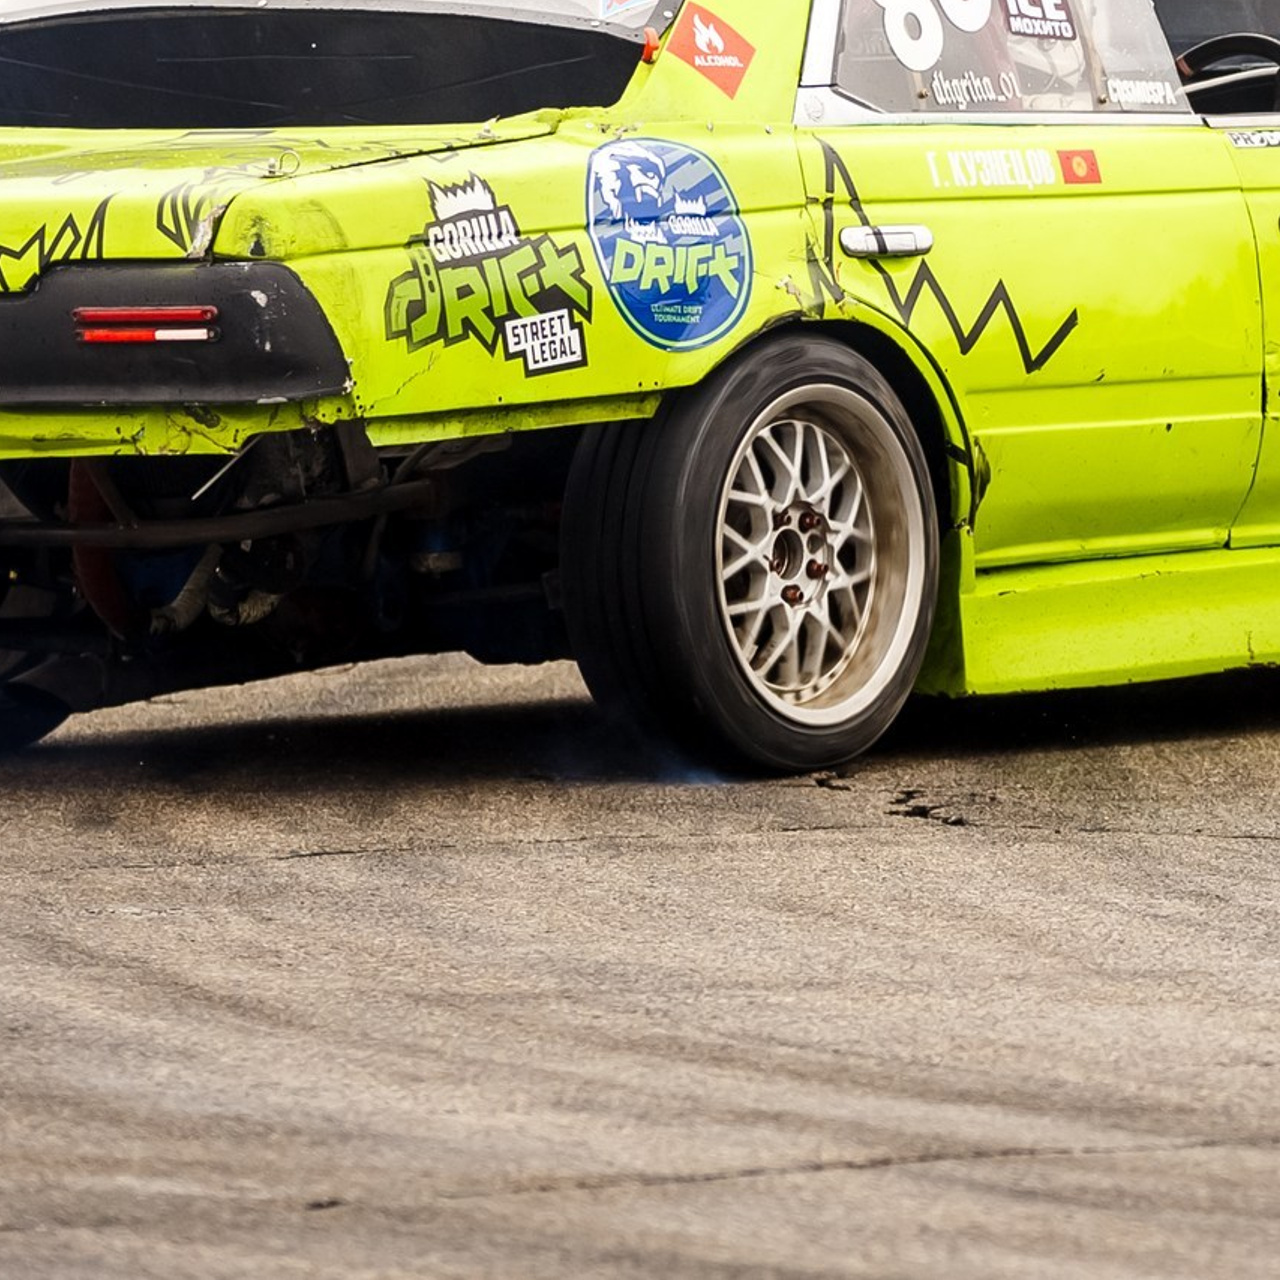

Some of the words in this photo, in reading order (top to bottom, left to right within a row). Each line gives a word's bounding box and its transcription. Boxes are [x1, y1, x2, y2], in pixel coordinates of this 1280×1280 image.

[1009, 16, 1075, 39] МОХИТО
[926, 150, 950, 188] Г.
[948, 149, 1056, 191] КУЗНЕЦОВ
[428, 210, 520, 261] GORILLA
[668, 215, 720, 237] GORILLA
[611, 237, 740, 299] DRIFT
[389, 234, 591, 347] DRIFT
[650, 303, 682, 314] ULTIMATE
[654, 314, 700, 324] TOURNAMENT
[510, 314, 567, 345] STREET
[531, 338, 578, 366] LEGAL
